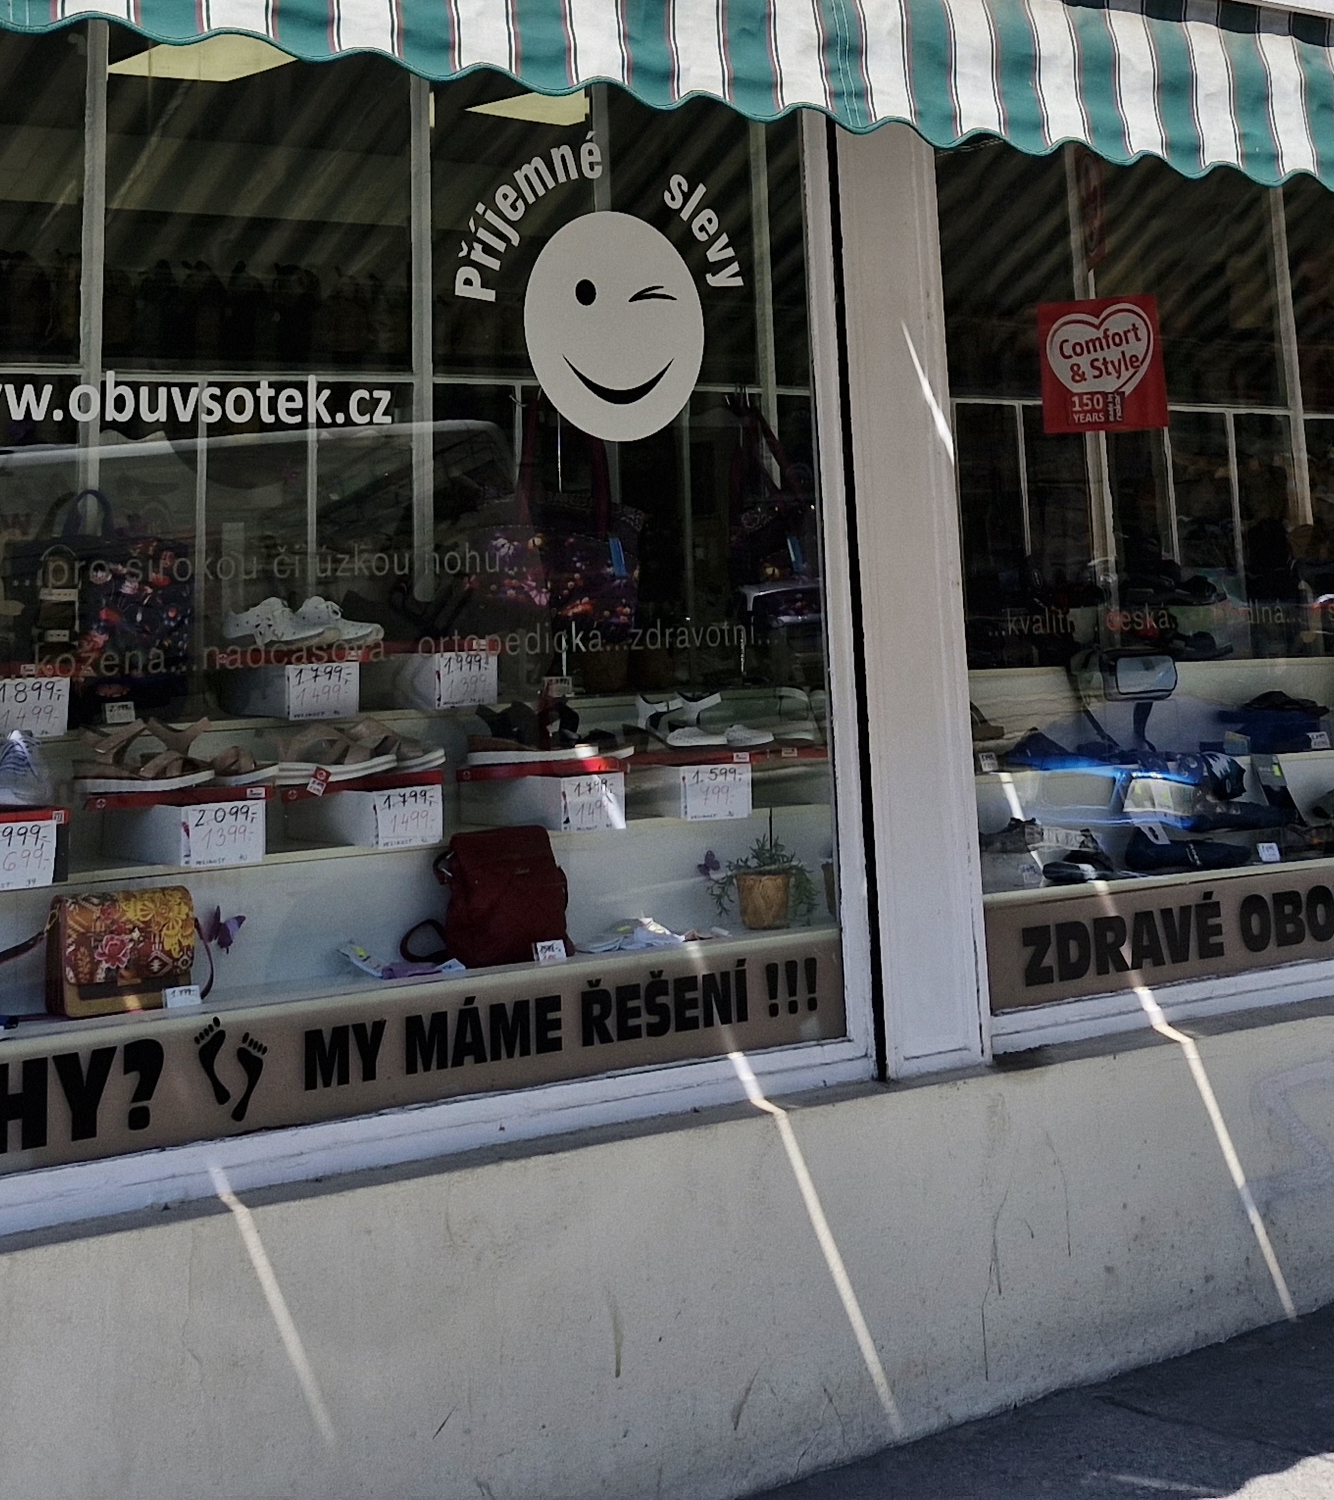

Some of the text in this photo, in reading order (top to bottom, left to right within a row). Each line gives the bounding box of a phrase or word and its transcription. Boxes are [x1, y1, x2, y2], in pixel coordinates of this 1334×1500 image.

[454, 131, 744, 302] Příjemné slevy
[1059, 323, 1142, 359] Comfort
[1069, 350, 1141, 383] & Style
[1071, 394, 1104, 411] 150
[1073, 412, 1105, 423] YEARS
[1022, 880, 1226, 988] ZDRAVÉ
[304, 1018, 386, 1093] MY
[404, 994, 564, 1077] MÁME
[580, 957, 750, 1048] ŘEŠENÍ
[765, 956, 819, 1019] !!!
